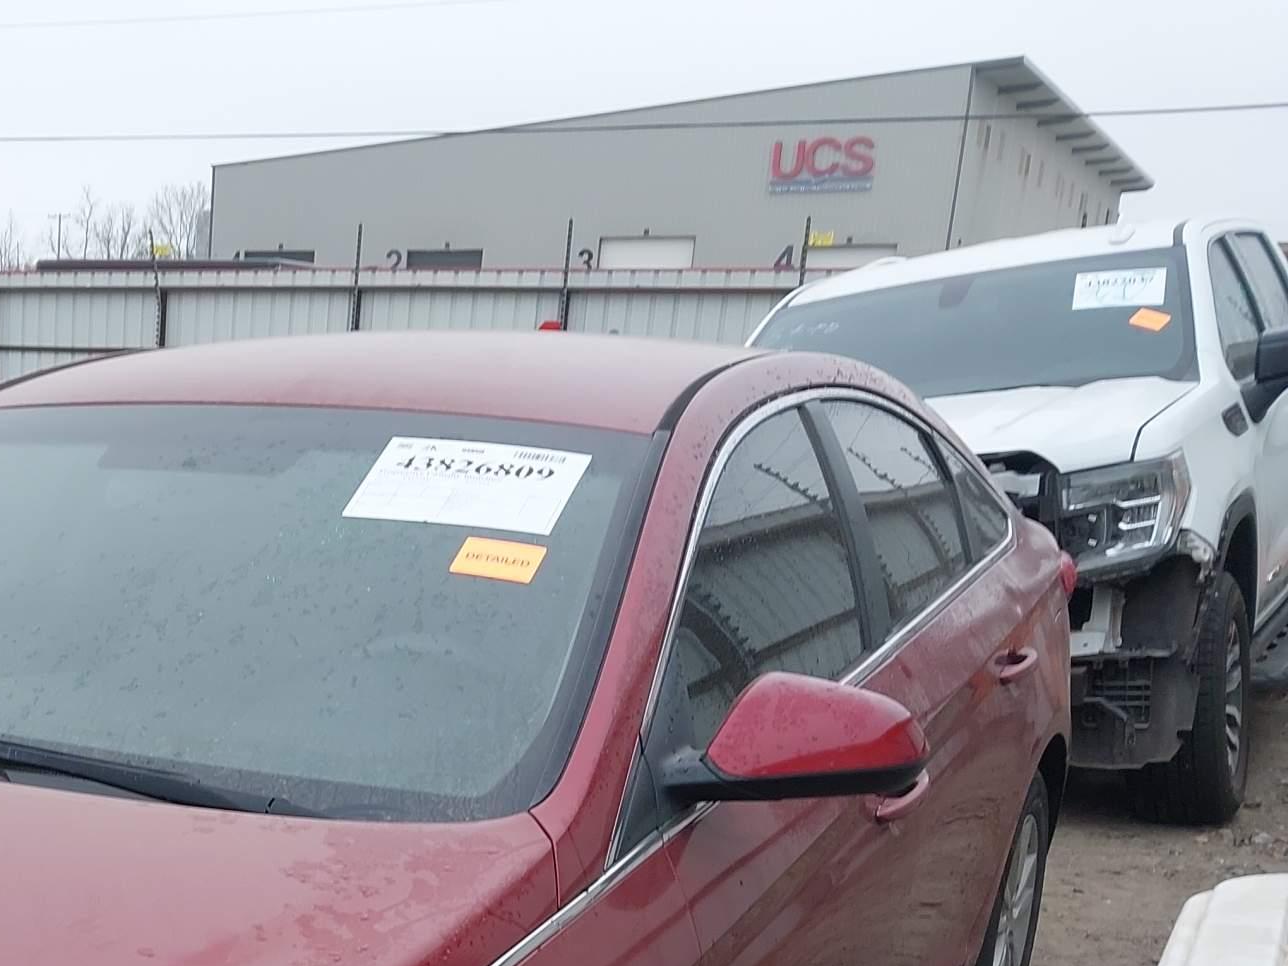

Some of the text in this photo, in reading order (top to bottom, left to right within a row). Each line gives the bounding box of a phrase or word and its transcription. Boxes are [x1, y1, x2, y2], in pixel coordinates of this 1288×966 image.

[771, 136, 875, 179] UCS
[578, 248, 594, 271] 3
[774, 245, 794, 272] 4
[396, 455, 555, 480] 43826809
[465, 551, 531, 567] DETAILED
